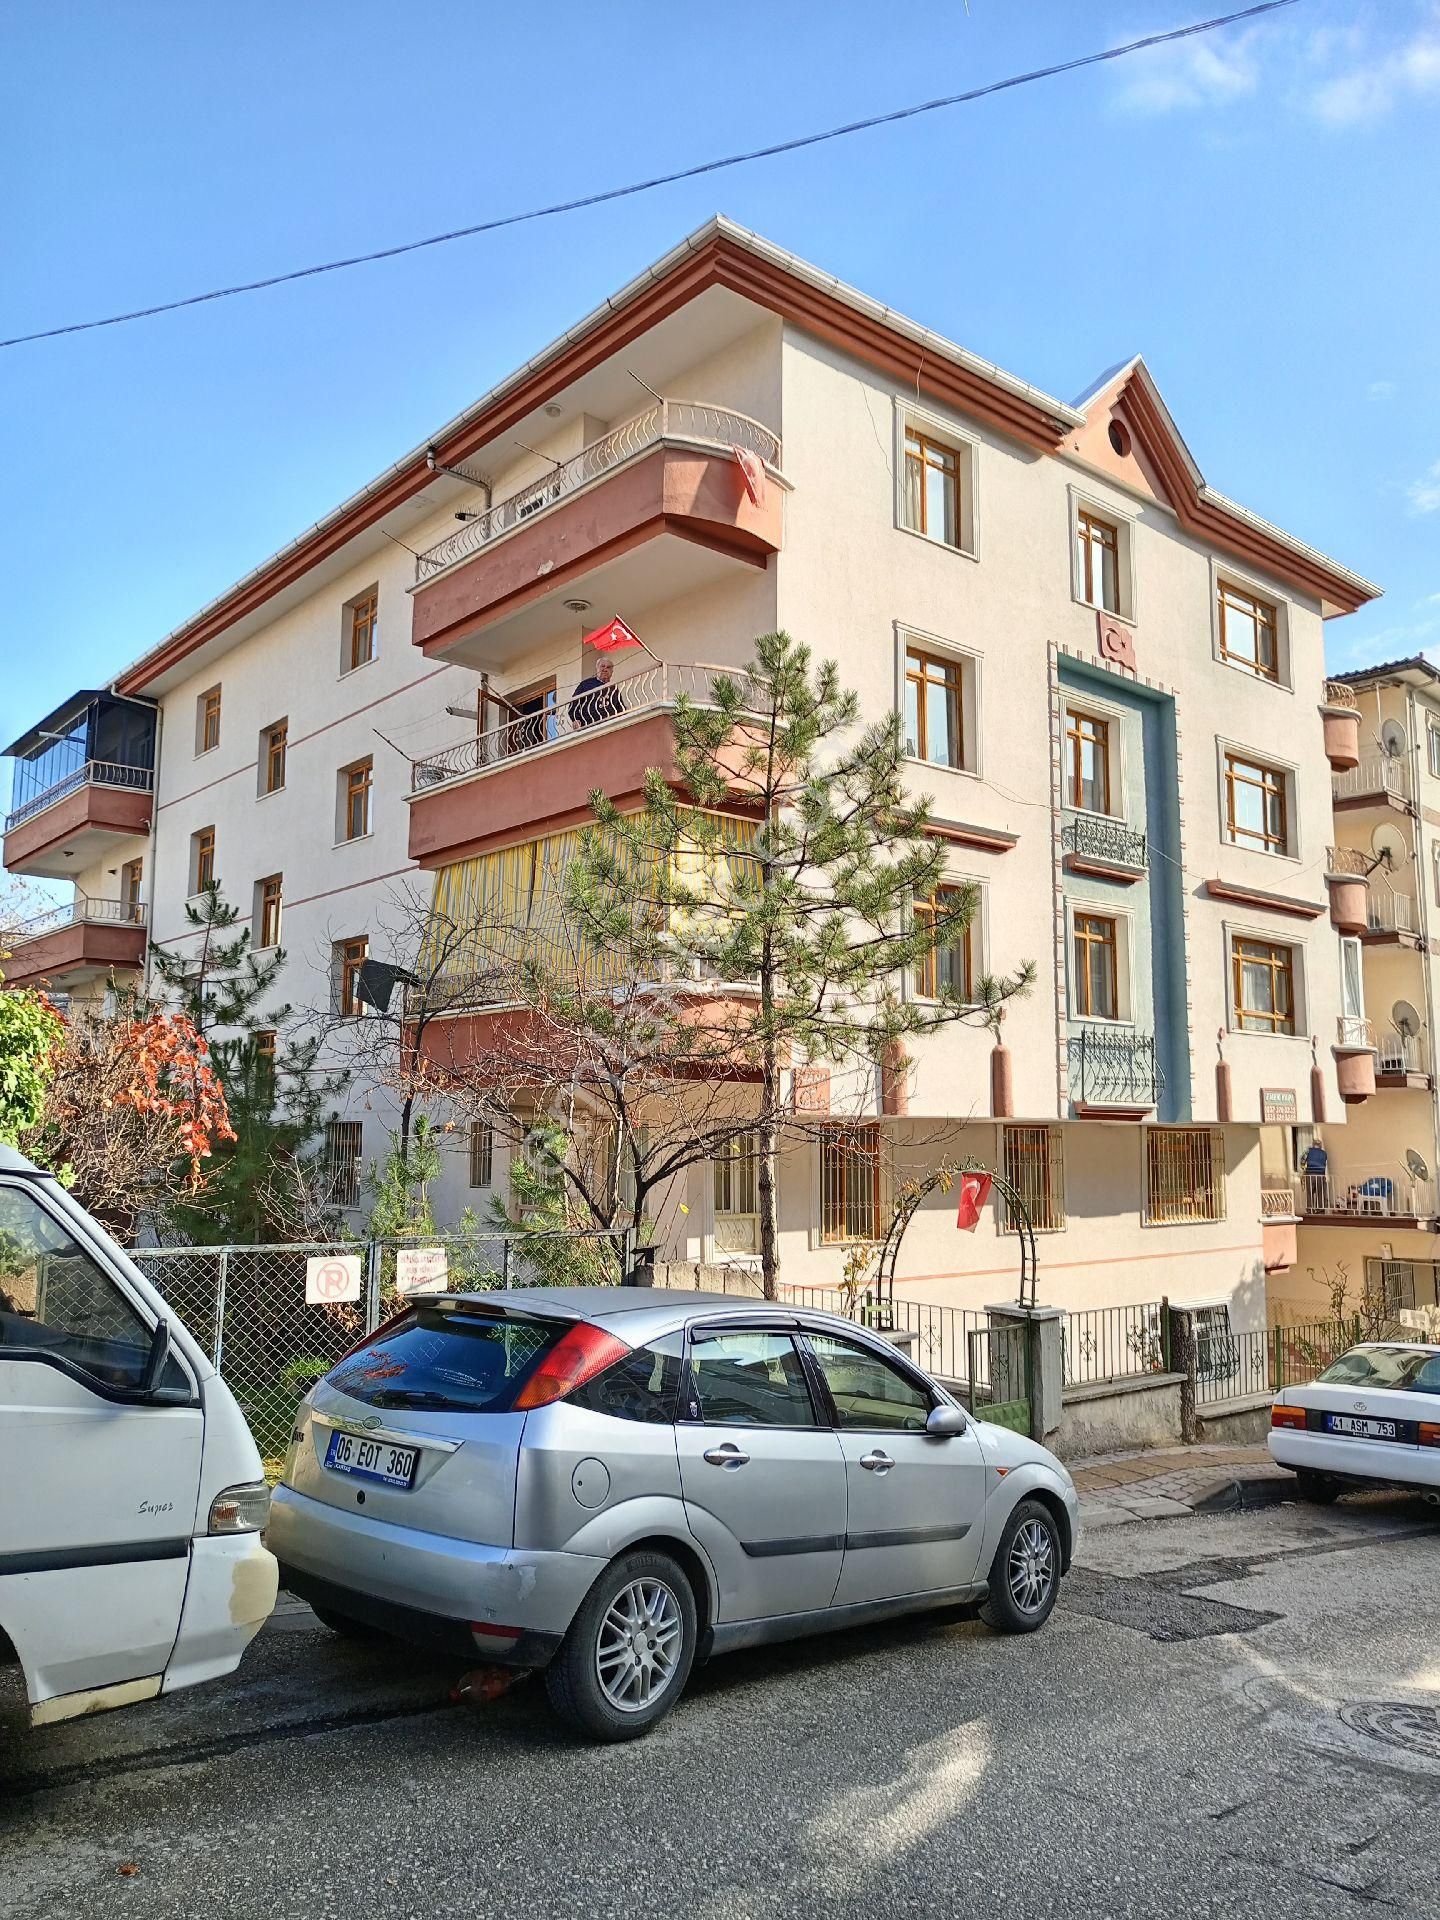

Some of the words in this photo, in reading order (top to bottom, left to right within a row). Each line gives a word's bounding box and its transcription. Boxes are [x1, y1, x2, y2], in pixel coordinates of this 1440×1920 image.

[1333, 1416, 1343, 1430] 41
[1351, 1419, 1369, 1433] ASM
[1376, 1422, 1395, 1436] 753
[336, 1436, 353, 1462] 06
[356, 1441, 383, 1470] EOT
[386, 1449, 412, 1478] 360
[138, 1500, 173, 1516] Super
